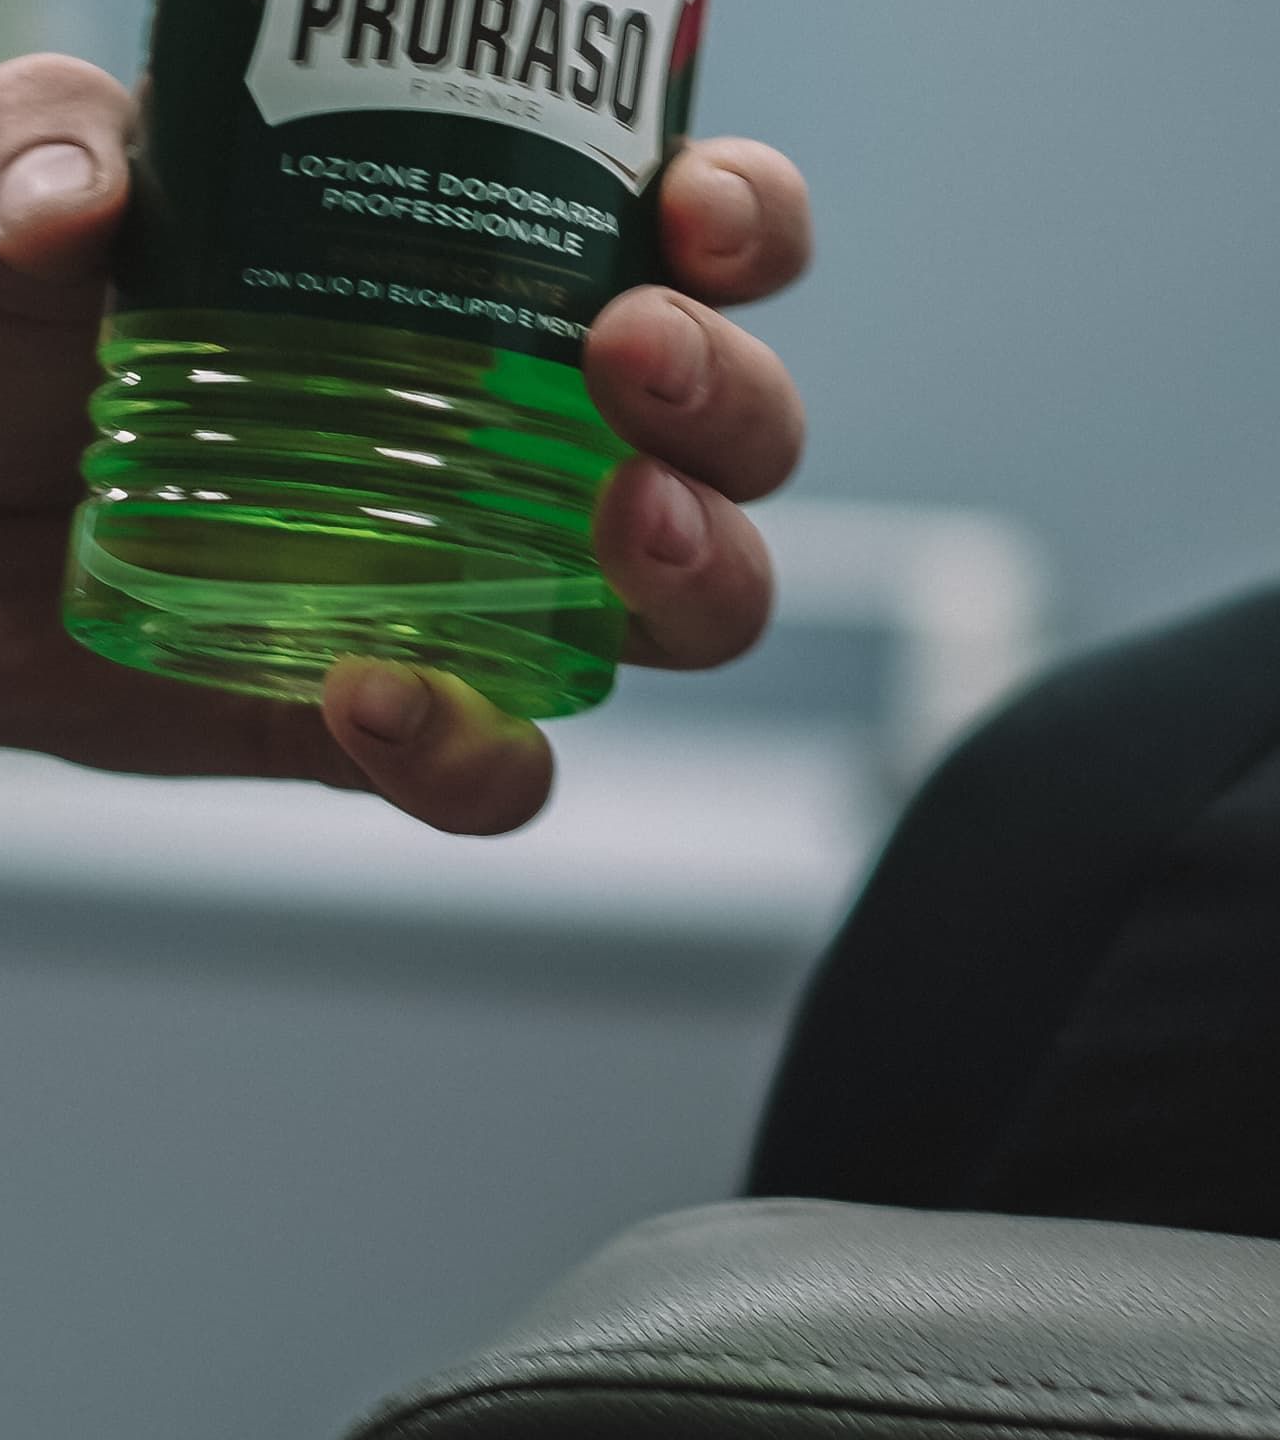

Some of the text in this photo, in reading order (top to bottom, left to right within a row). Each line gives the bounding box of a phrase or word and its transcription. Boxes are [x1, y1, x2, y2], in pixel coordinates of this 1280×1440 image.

[408, 77, 544, 122] FIRENZE
[280, 152, 620, 238] LOZIONE DOPOBARBA
[321, 186, 585, 258] PROFESSIONALE
[241, 267, 592, 339] CON OLIO DI EUCALIPTO E MENT
